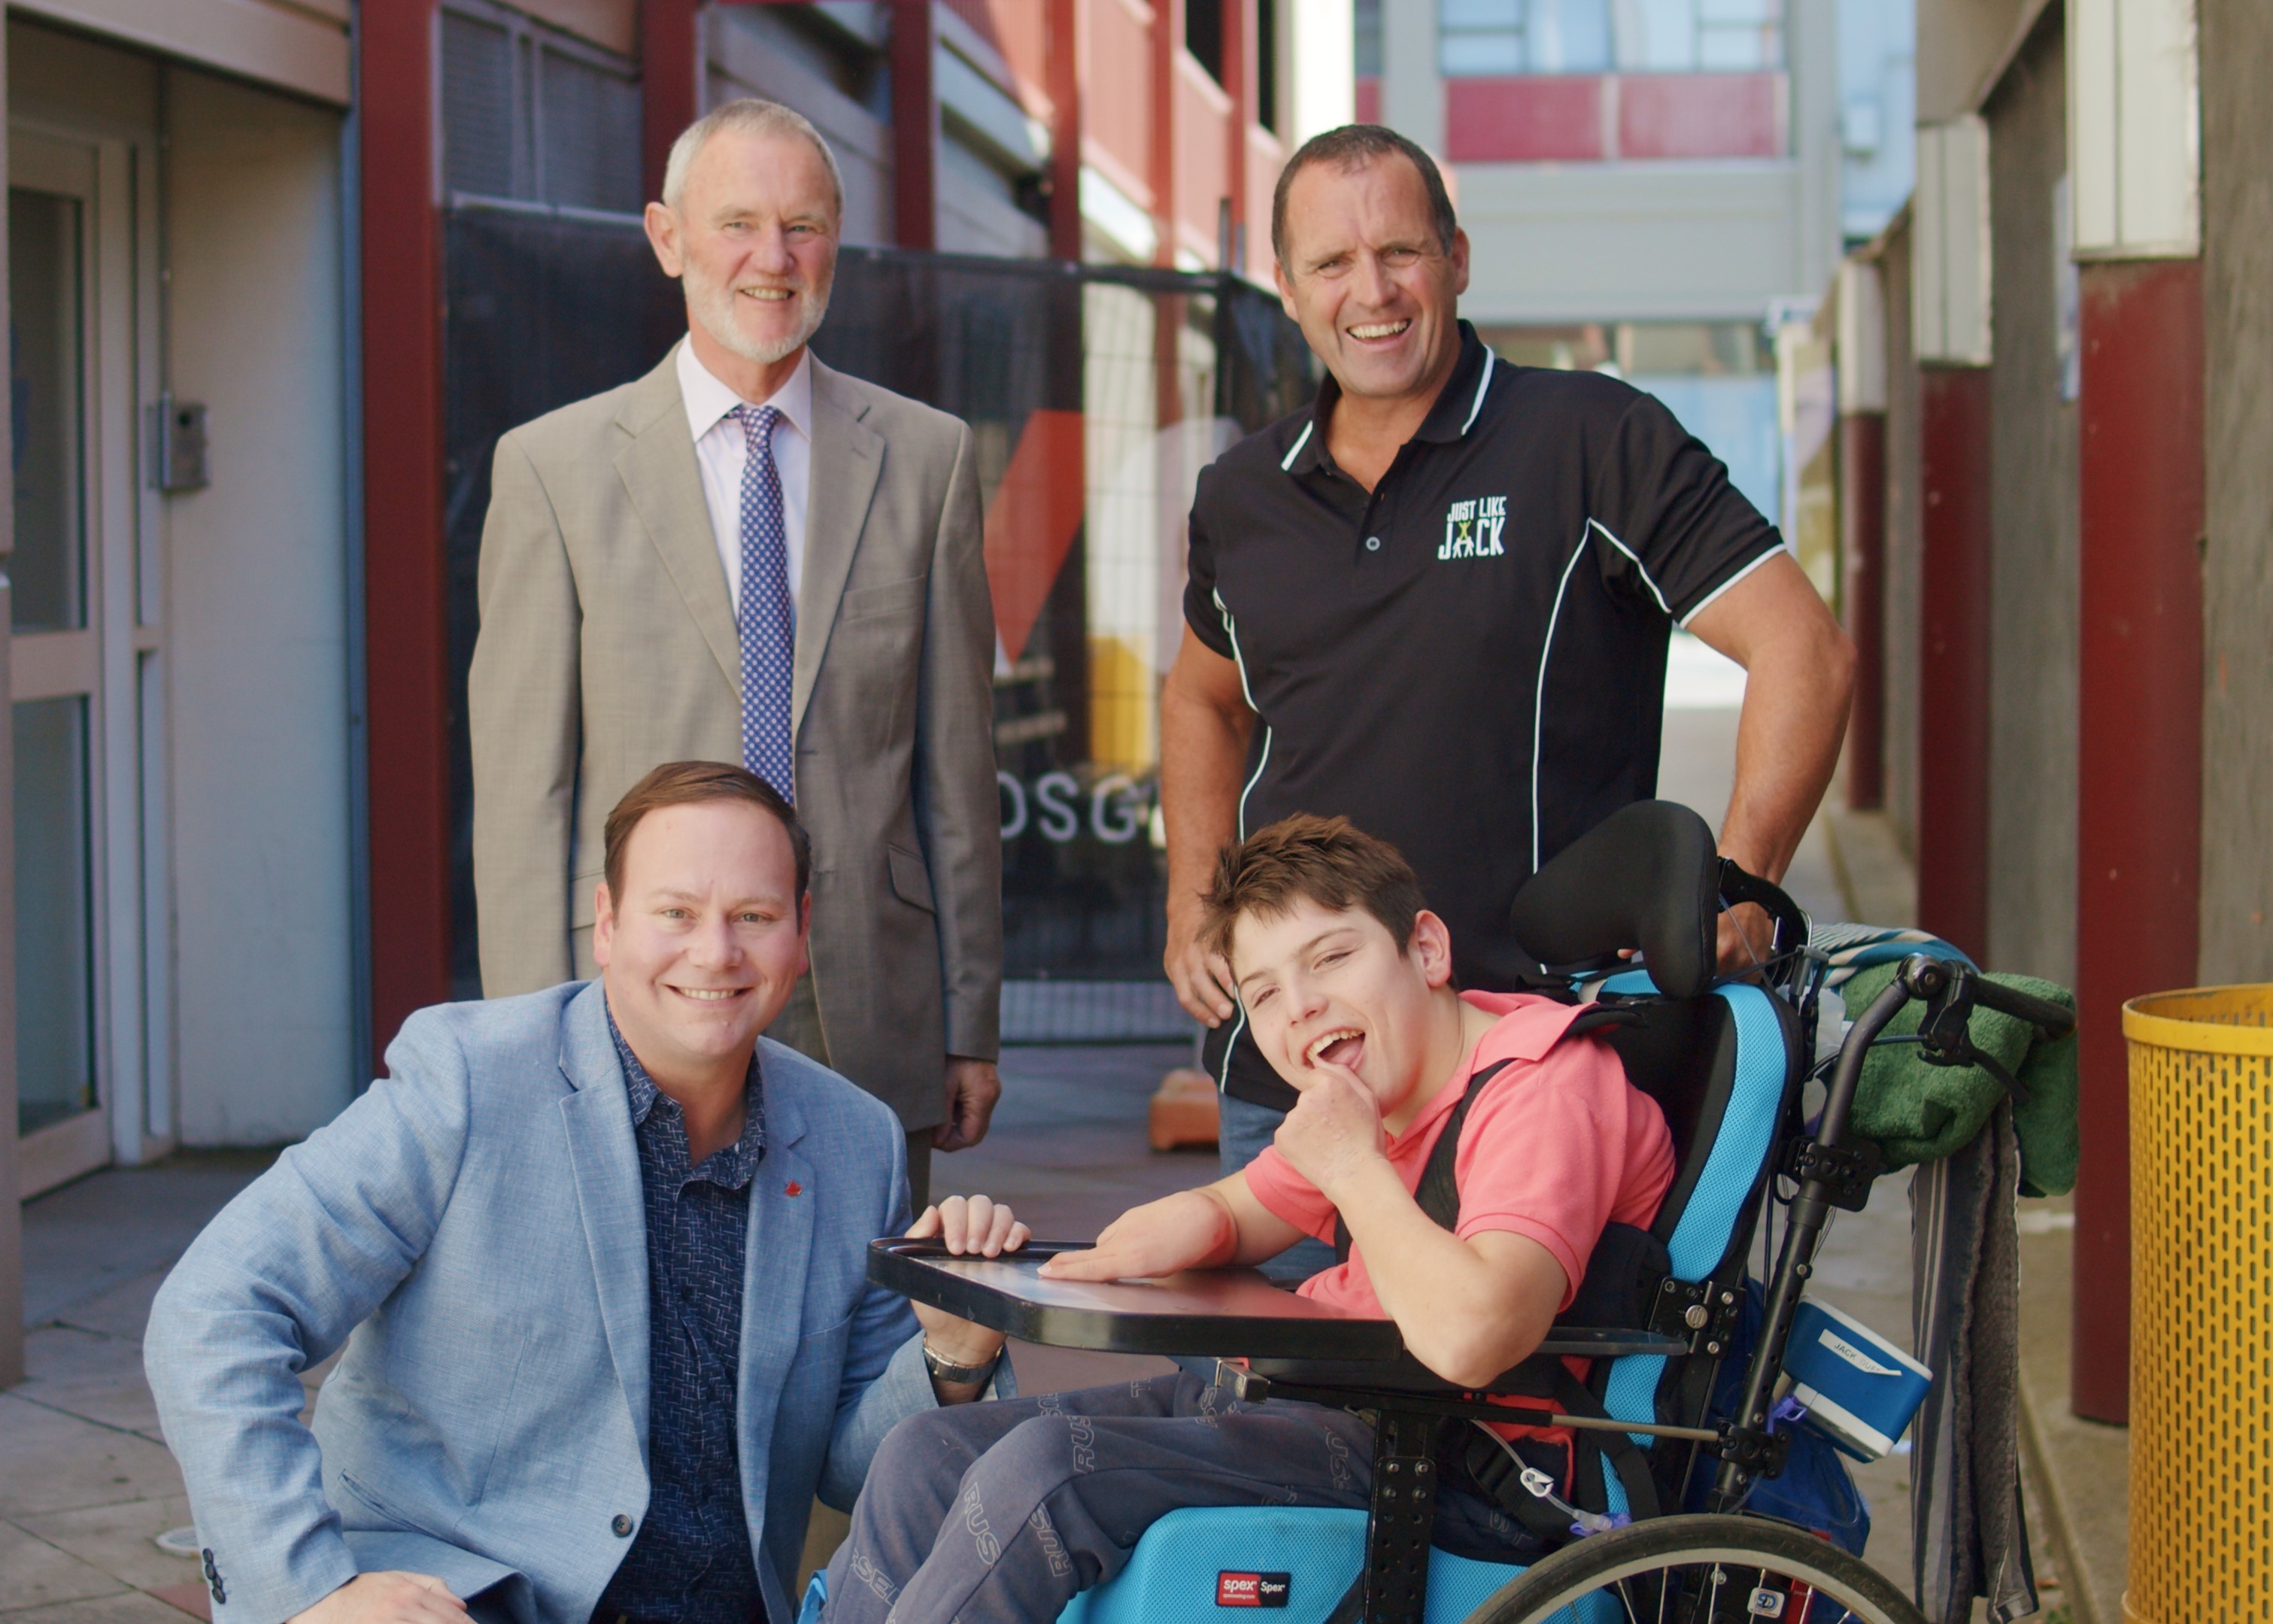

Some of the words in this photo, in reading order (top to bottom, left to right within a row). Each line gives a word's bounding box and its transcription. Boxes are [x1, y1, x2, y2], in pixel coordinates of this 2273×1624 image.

[1446, 500, 1476, 523] JUST
[1479, 496, 1507, 518] LIKE
[1437, 516, 1506, 560] JACK
[1834, 1343, 1857, 1360] JACK
[1224, 1579, 1255, 1593] spex
[1261, 1580, 1285, 1595] Spex
